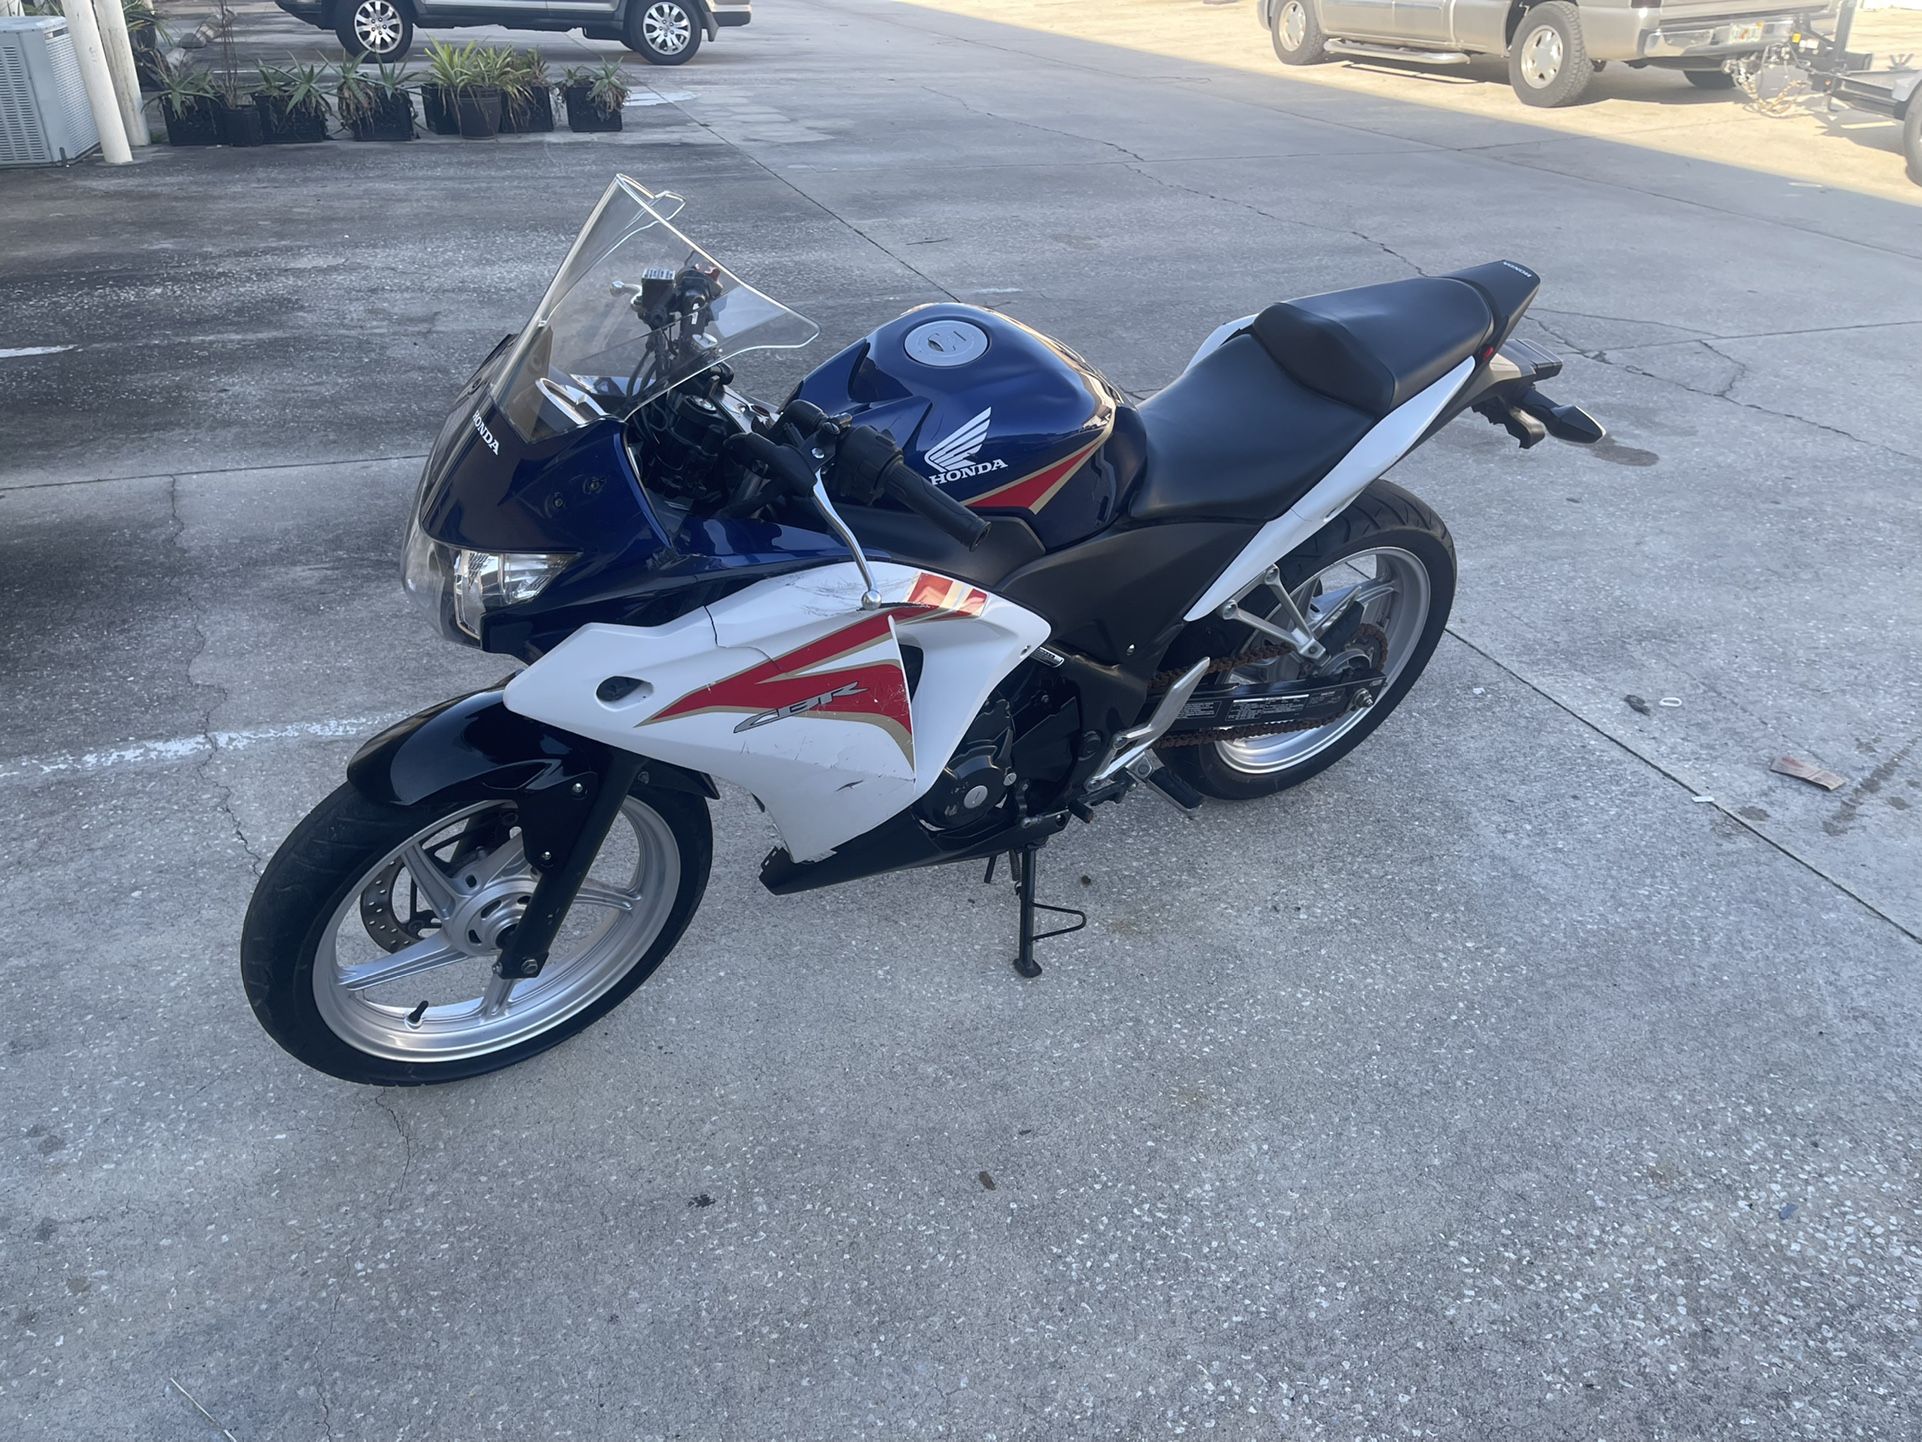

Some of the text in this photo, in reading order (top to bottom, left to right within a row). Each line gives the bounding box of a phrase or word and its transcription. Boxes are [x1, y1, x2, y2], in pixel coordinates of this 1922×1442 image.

[472, 409, 499, 456] HONDA
[929, 458, 1008, 486] HONDA
[733, 680, 868, 733] CBR
